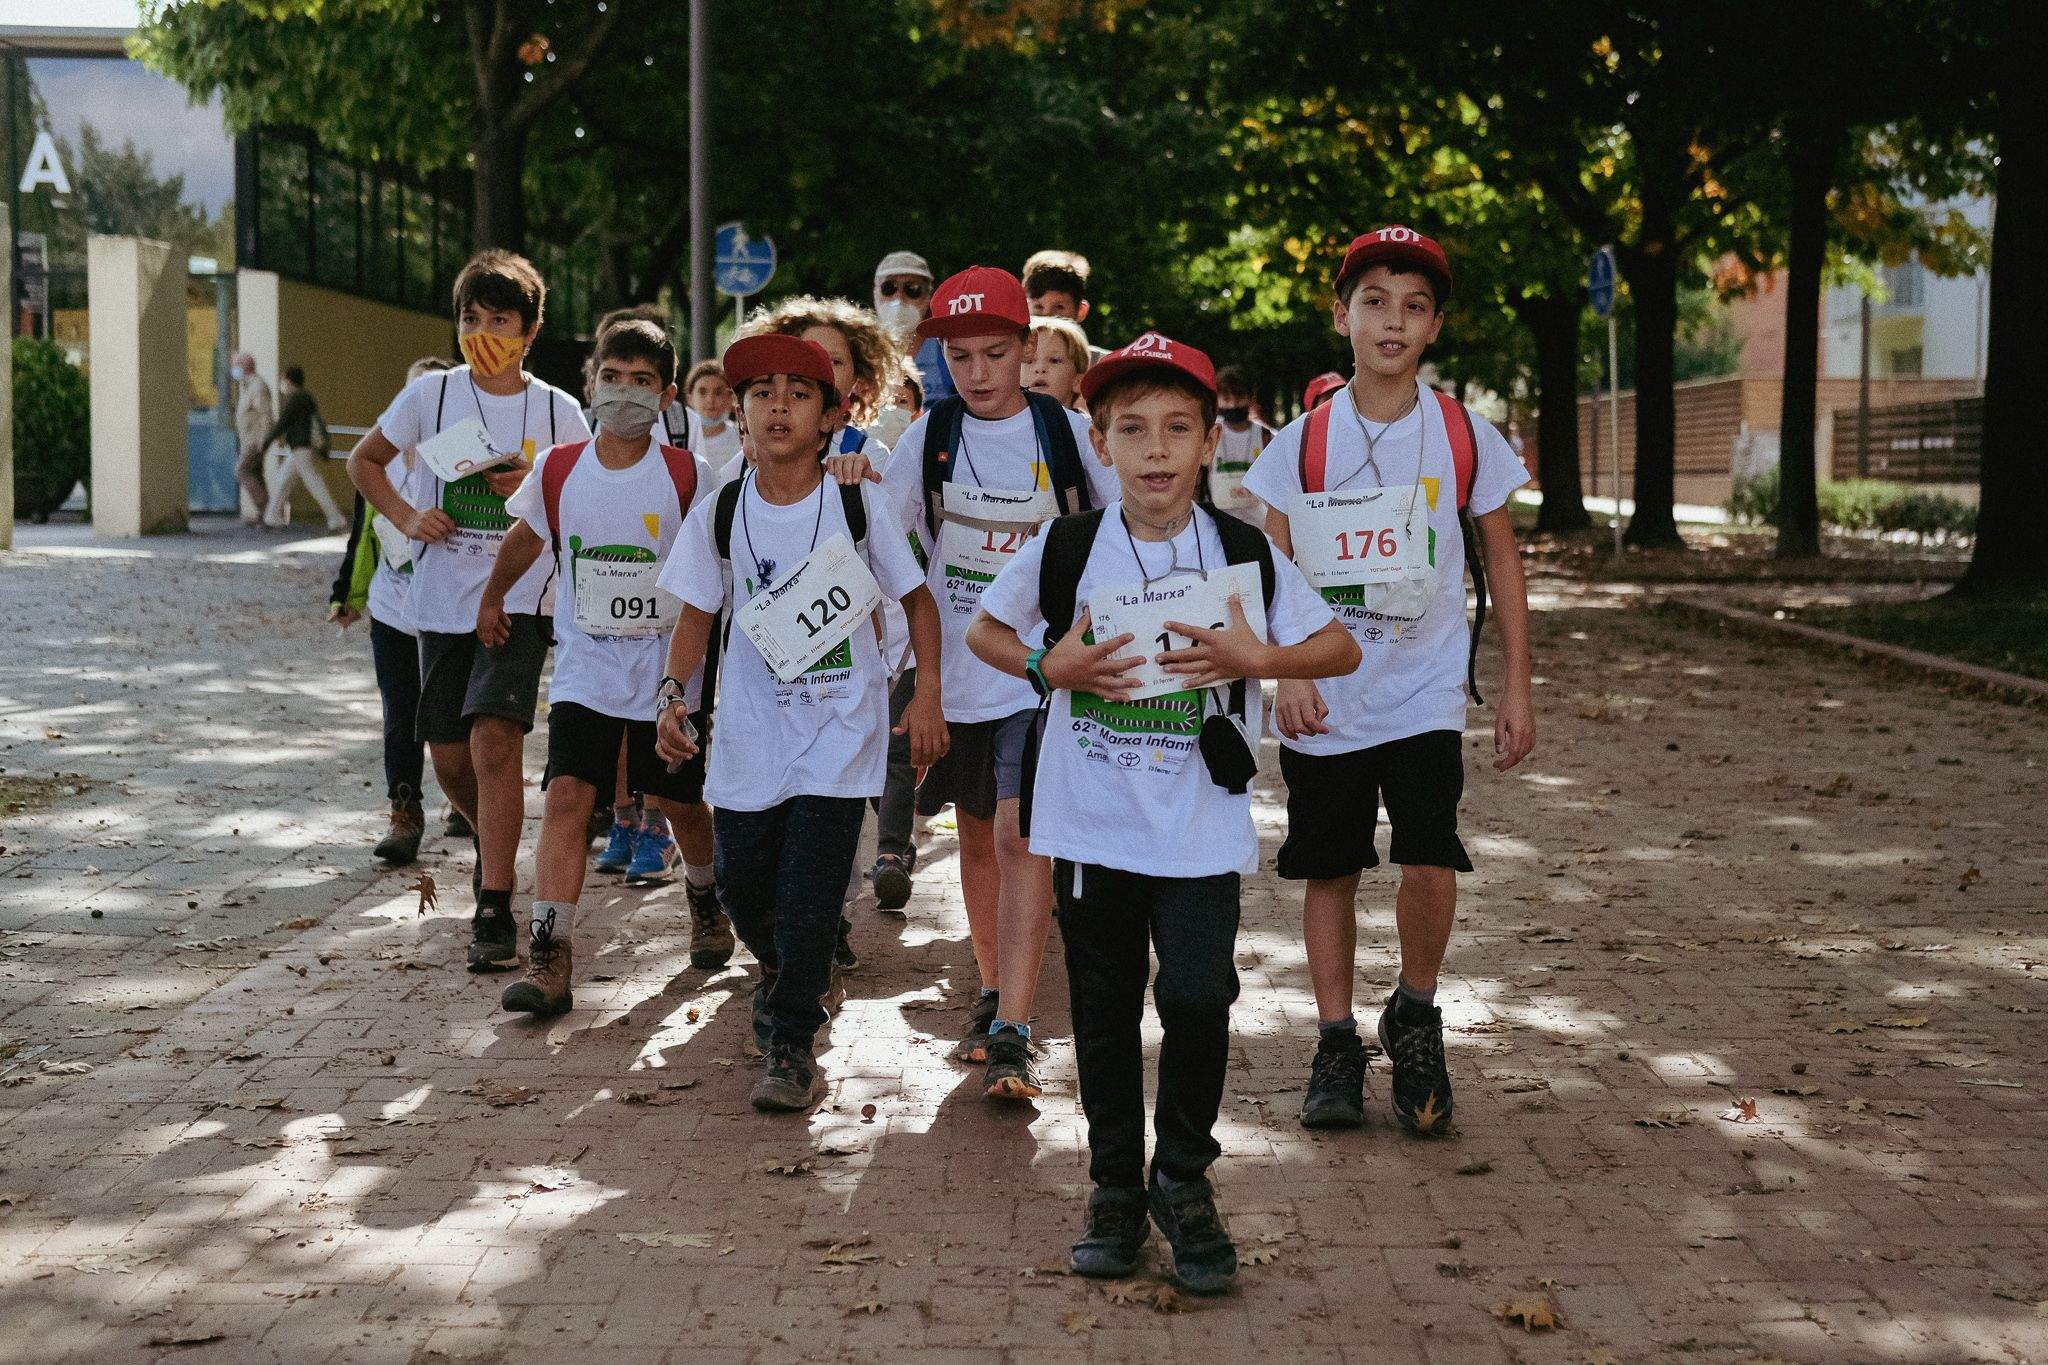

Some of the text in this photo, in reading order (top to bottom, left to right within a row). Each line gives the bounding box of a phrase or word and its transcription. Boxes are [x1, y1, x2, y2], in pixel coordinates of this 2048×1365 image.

[18, 129, 72, 194] A
[1376, 227, 1423, 242] TOT
[948, 293, 985, 315] TOT
[485, 533, 504, 541] Infa
[982, 531, 1017, 553] 12
[1335, 528, 1398, 561] 176
[610, 597, 660, 619] 091
[796, 586, 851, 638] 120
[1343, 607, 1383, 620] Marxa
[811, 671, 851, 685] Infantil
[1099, 727, 1143, 746] Marxa
[1146, 735, 1194, 752] Infanti
[1086, 750, 1108, 761] Ama
